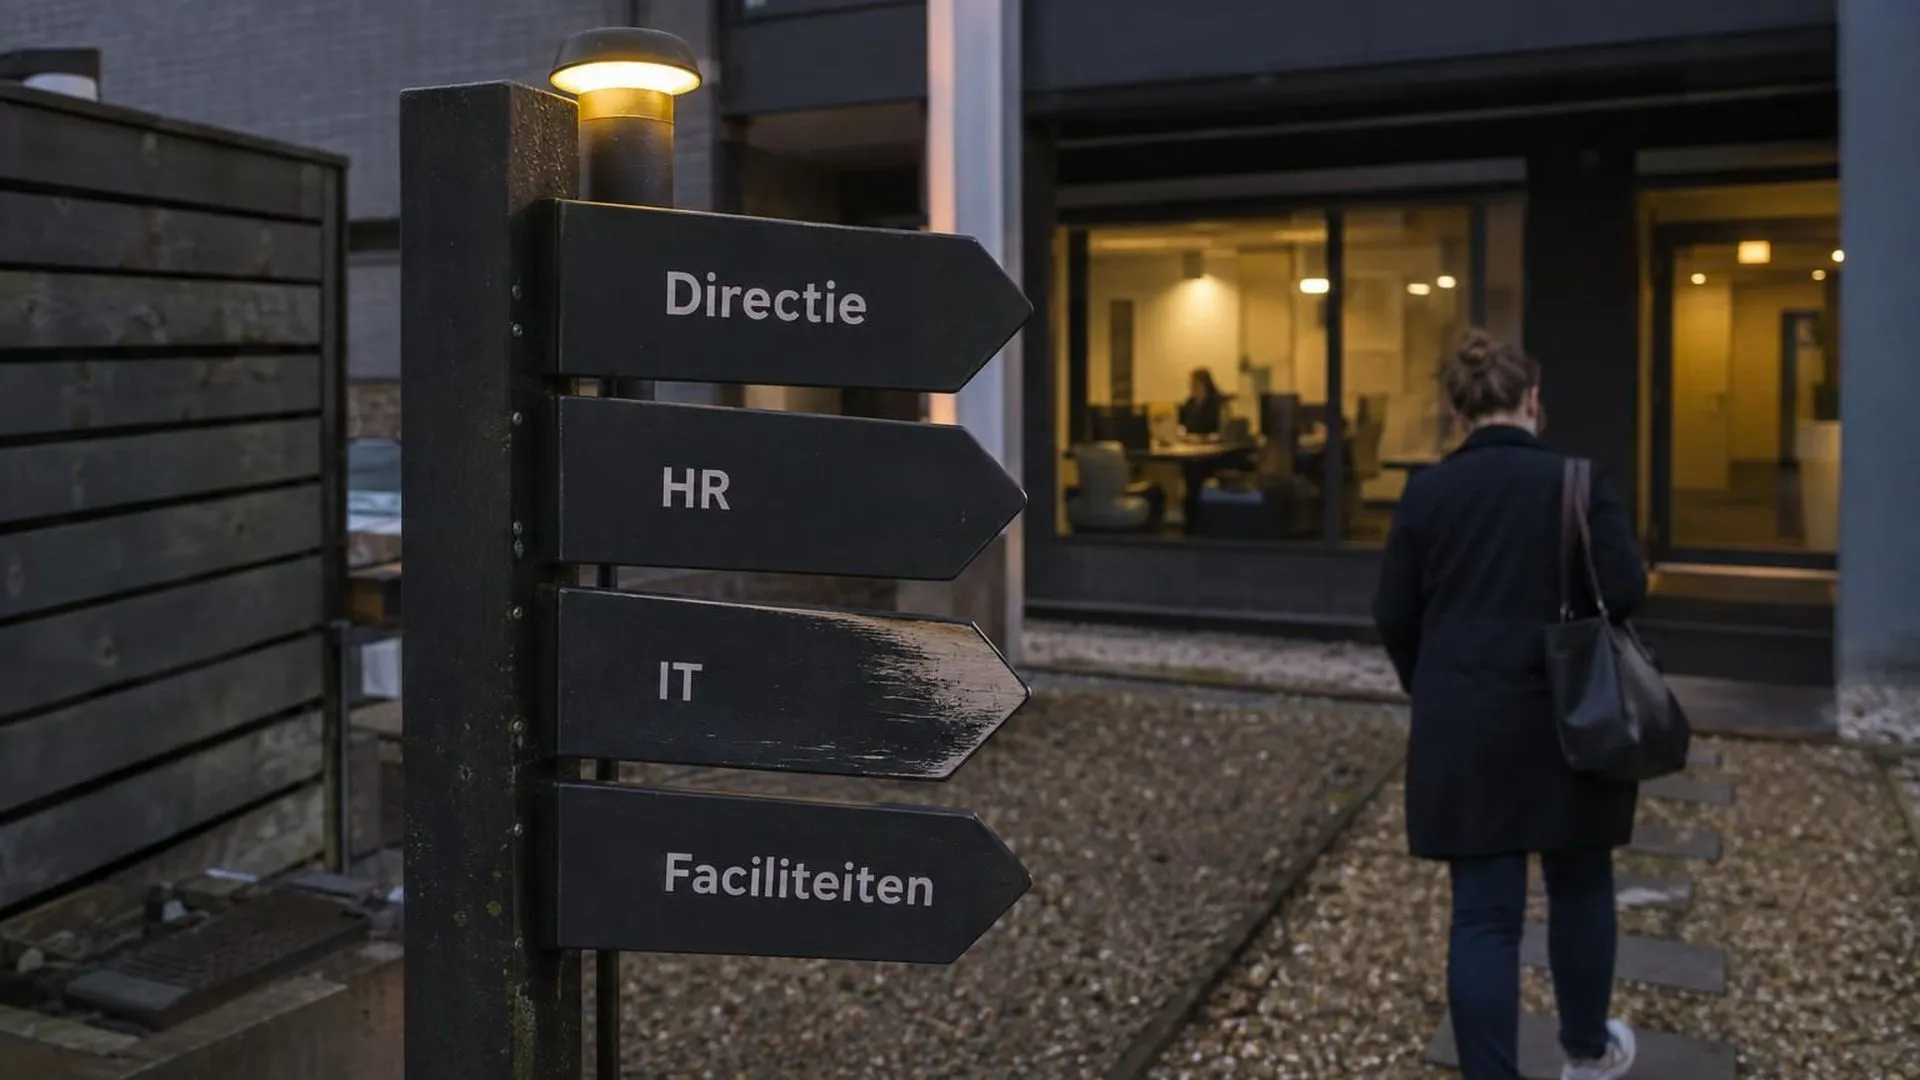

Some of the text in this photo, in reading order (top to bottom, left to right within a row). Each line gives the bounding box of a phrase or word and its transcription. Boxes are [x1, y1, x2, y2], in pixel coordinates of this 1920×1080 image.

[666, 271, 867, 325] Directie
[661, 466, 730, 510] HR
[659, 661, 703, 701] IT
[665, 852, 933, 906] Faciliteiten
